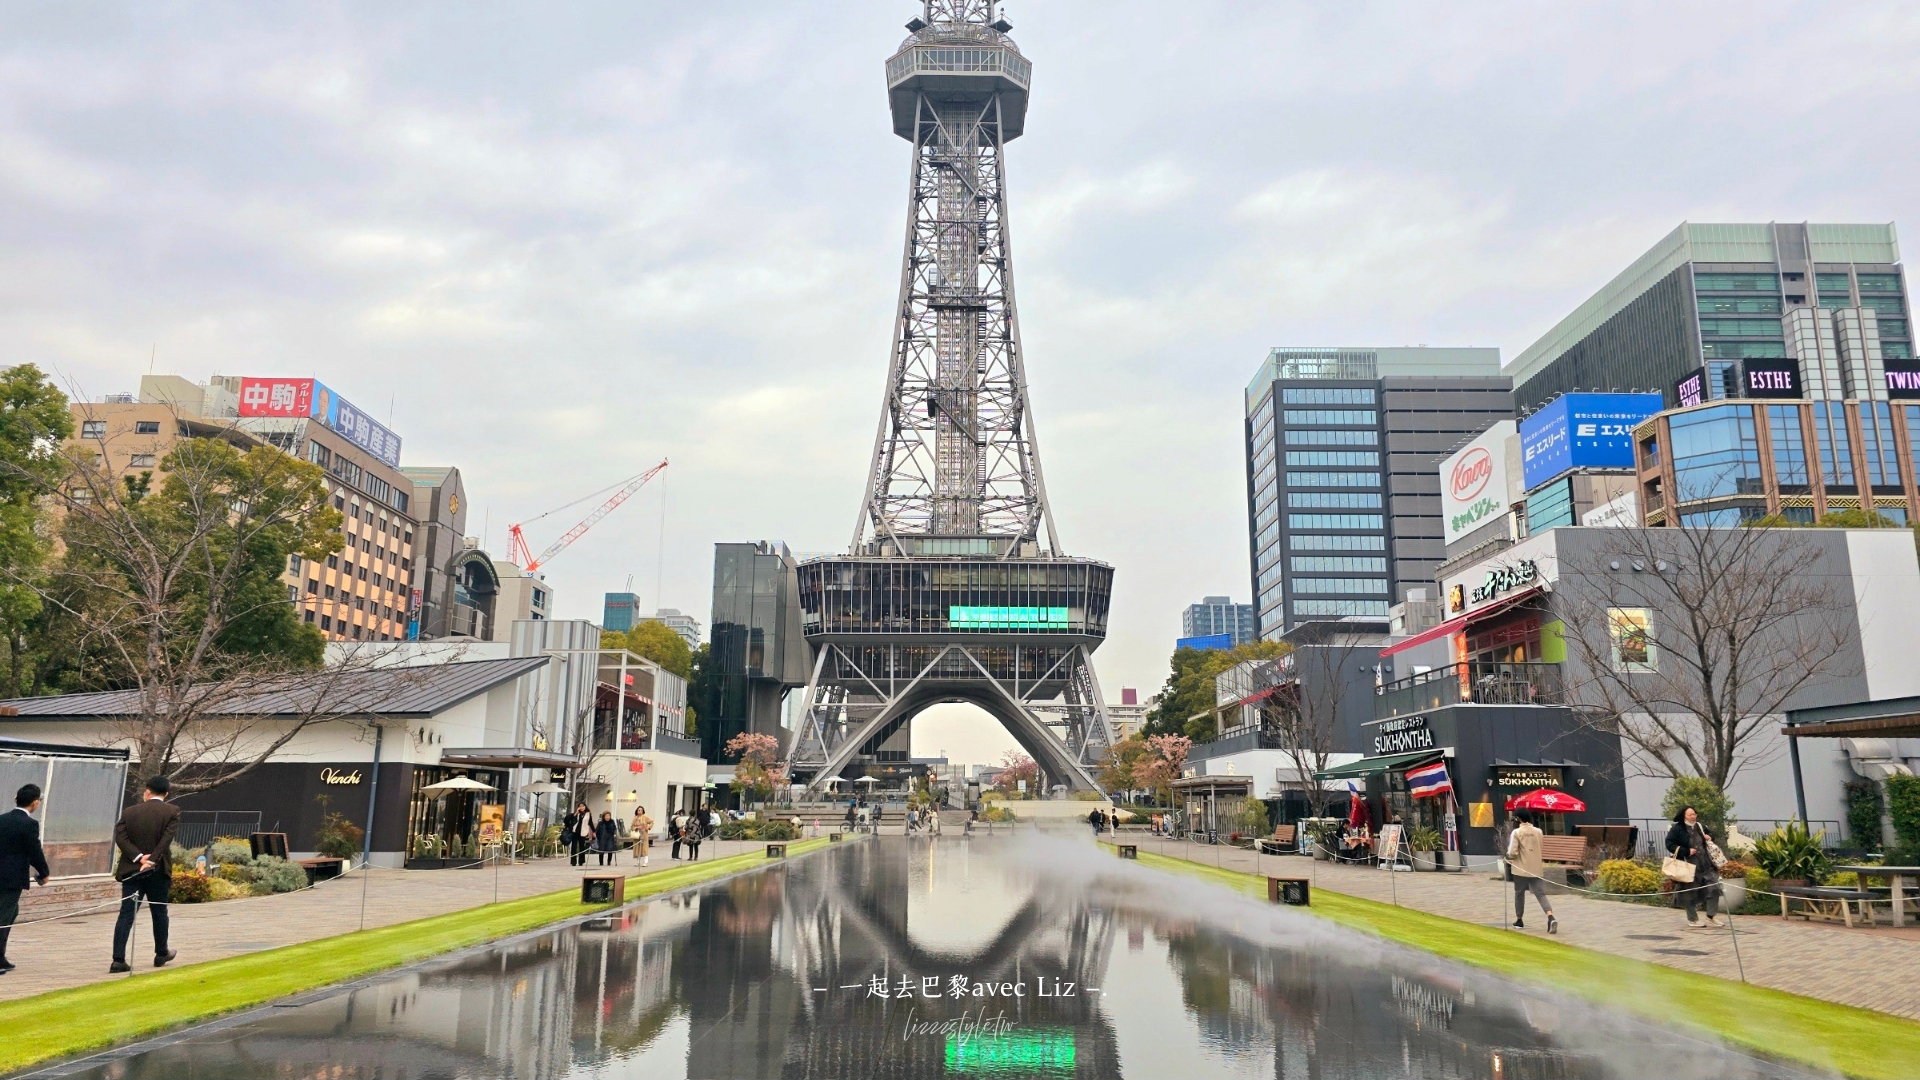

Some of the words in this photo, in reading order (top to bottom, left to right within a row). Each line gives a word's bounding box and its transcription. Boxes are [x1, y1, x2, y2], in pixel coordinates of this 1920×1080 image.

[1678, 374, 1700, 400] ESTHE
[1750, 371, 1792, 389] ESTHE
[1885, 371, 1920, 389] TWIN
[244, 383, 297, 411] 中駒
[298, 382, 310, 412] グループ
[339, 407, 397, 464] 中駒産業
[1536, 427, 1566, 455] エスリード
[1453, 456, 1490, 495] Kowa
[1374, 728, 1433, 753] SUKHONTHA
[320, 767, 362, 785] Venchi
[1498, 778, 1560, 786] SUKHONTHA
